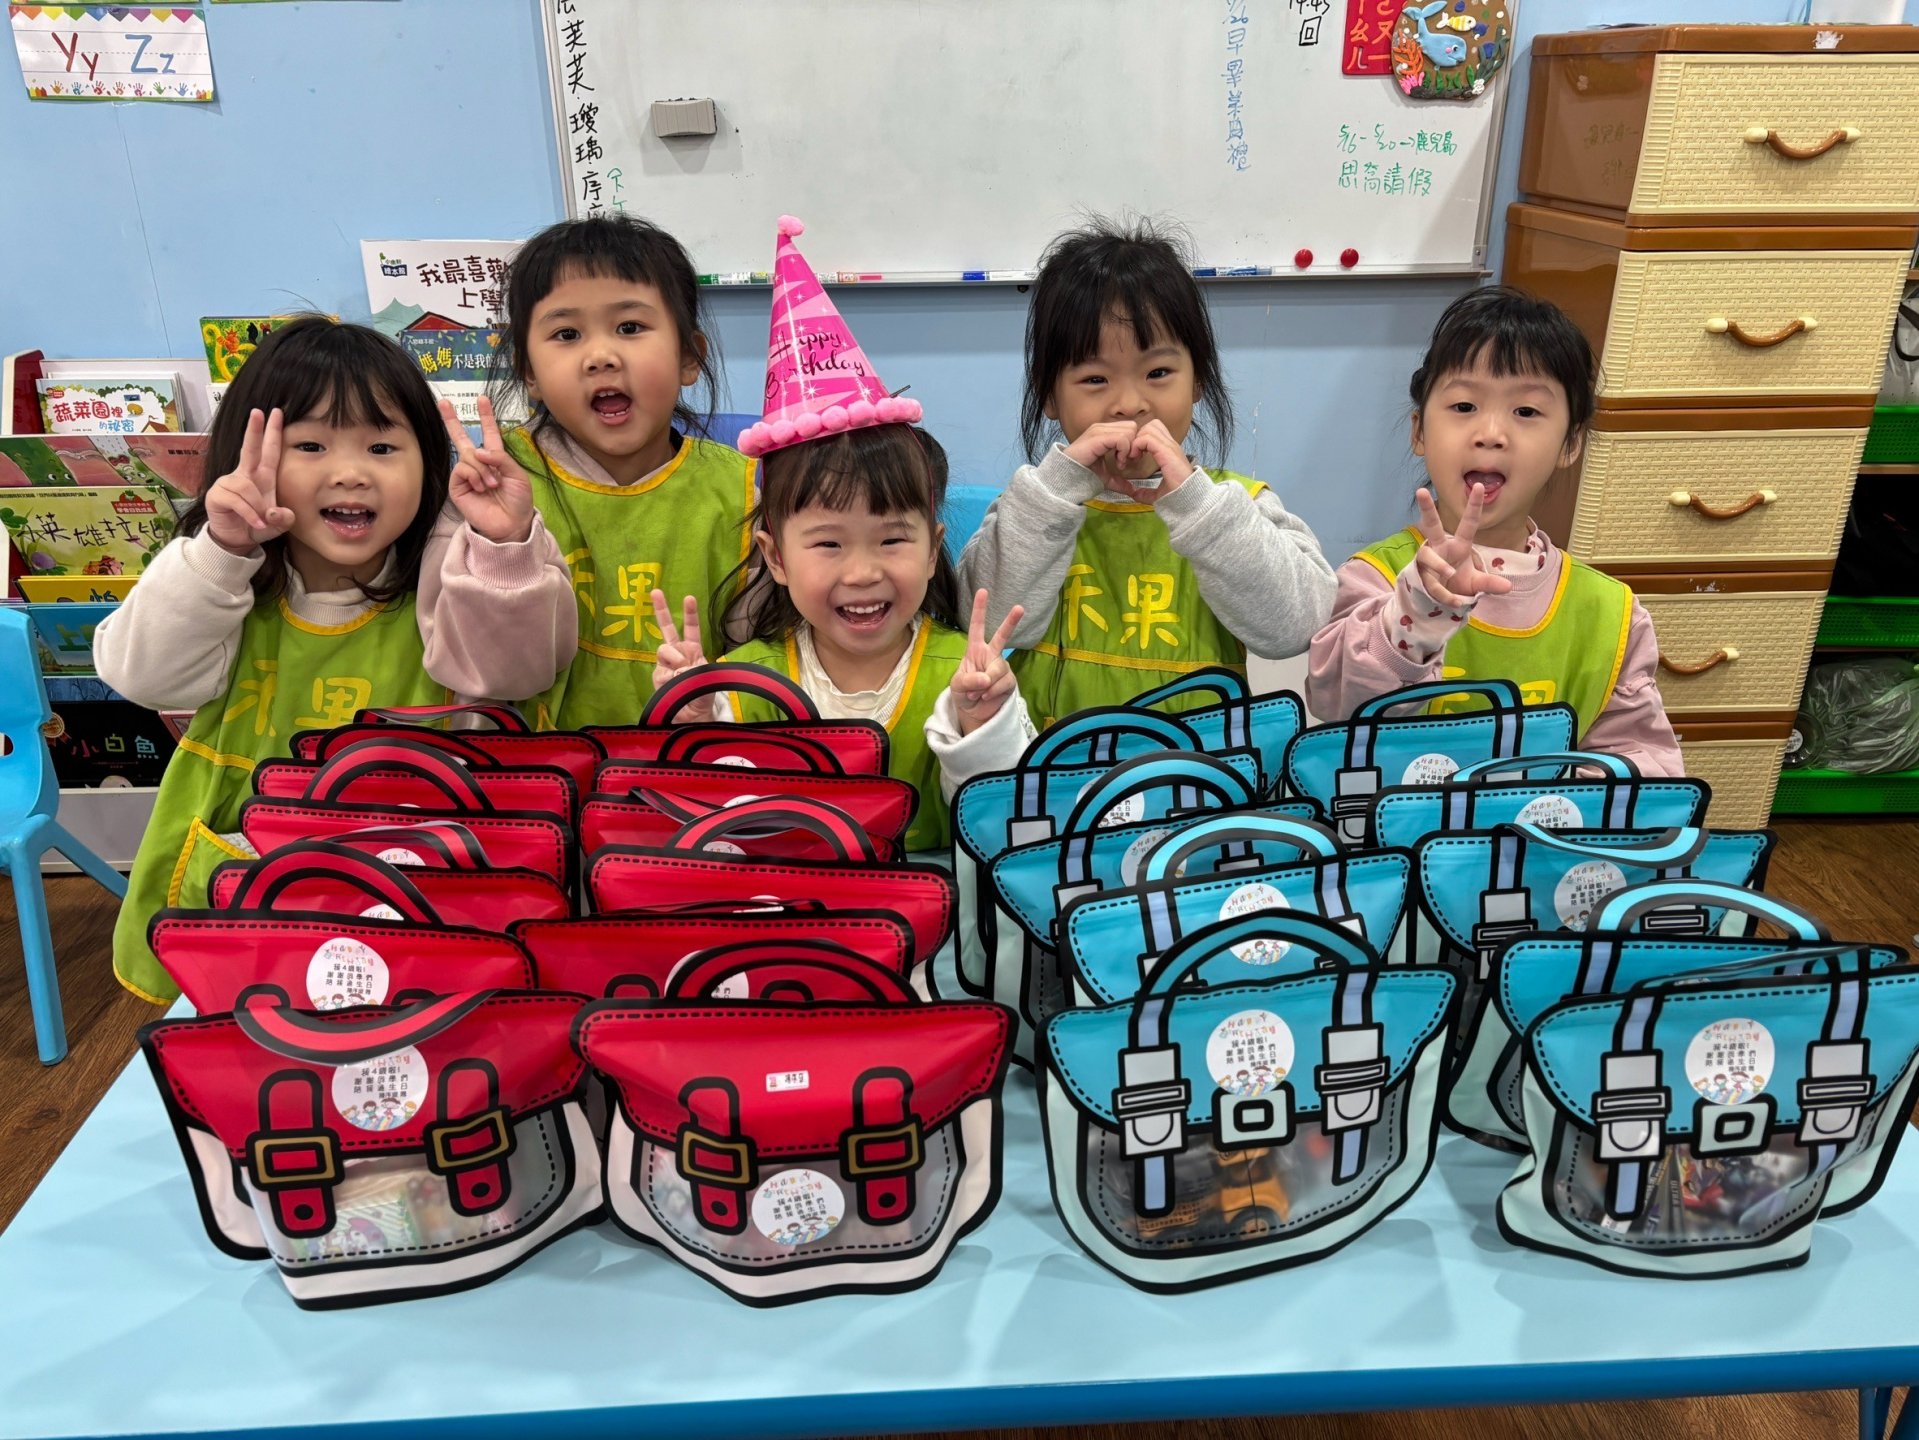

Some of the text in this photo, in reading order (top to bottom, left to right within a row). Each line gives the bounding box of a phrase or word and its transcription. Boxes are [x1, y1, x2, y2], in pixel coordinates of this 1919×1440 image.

[1298, 15, 1322, 46] 回
[51, 32, 177, 81] Yy Zz
[770, 330, 842, 362] Happy
[765, 350, 865, 402] Birthday
[53, 401, 123, 423] 蔬菜園裡
